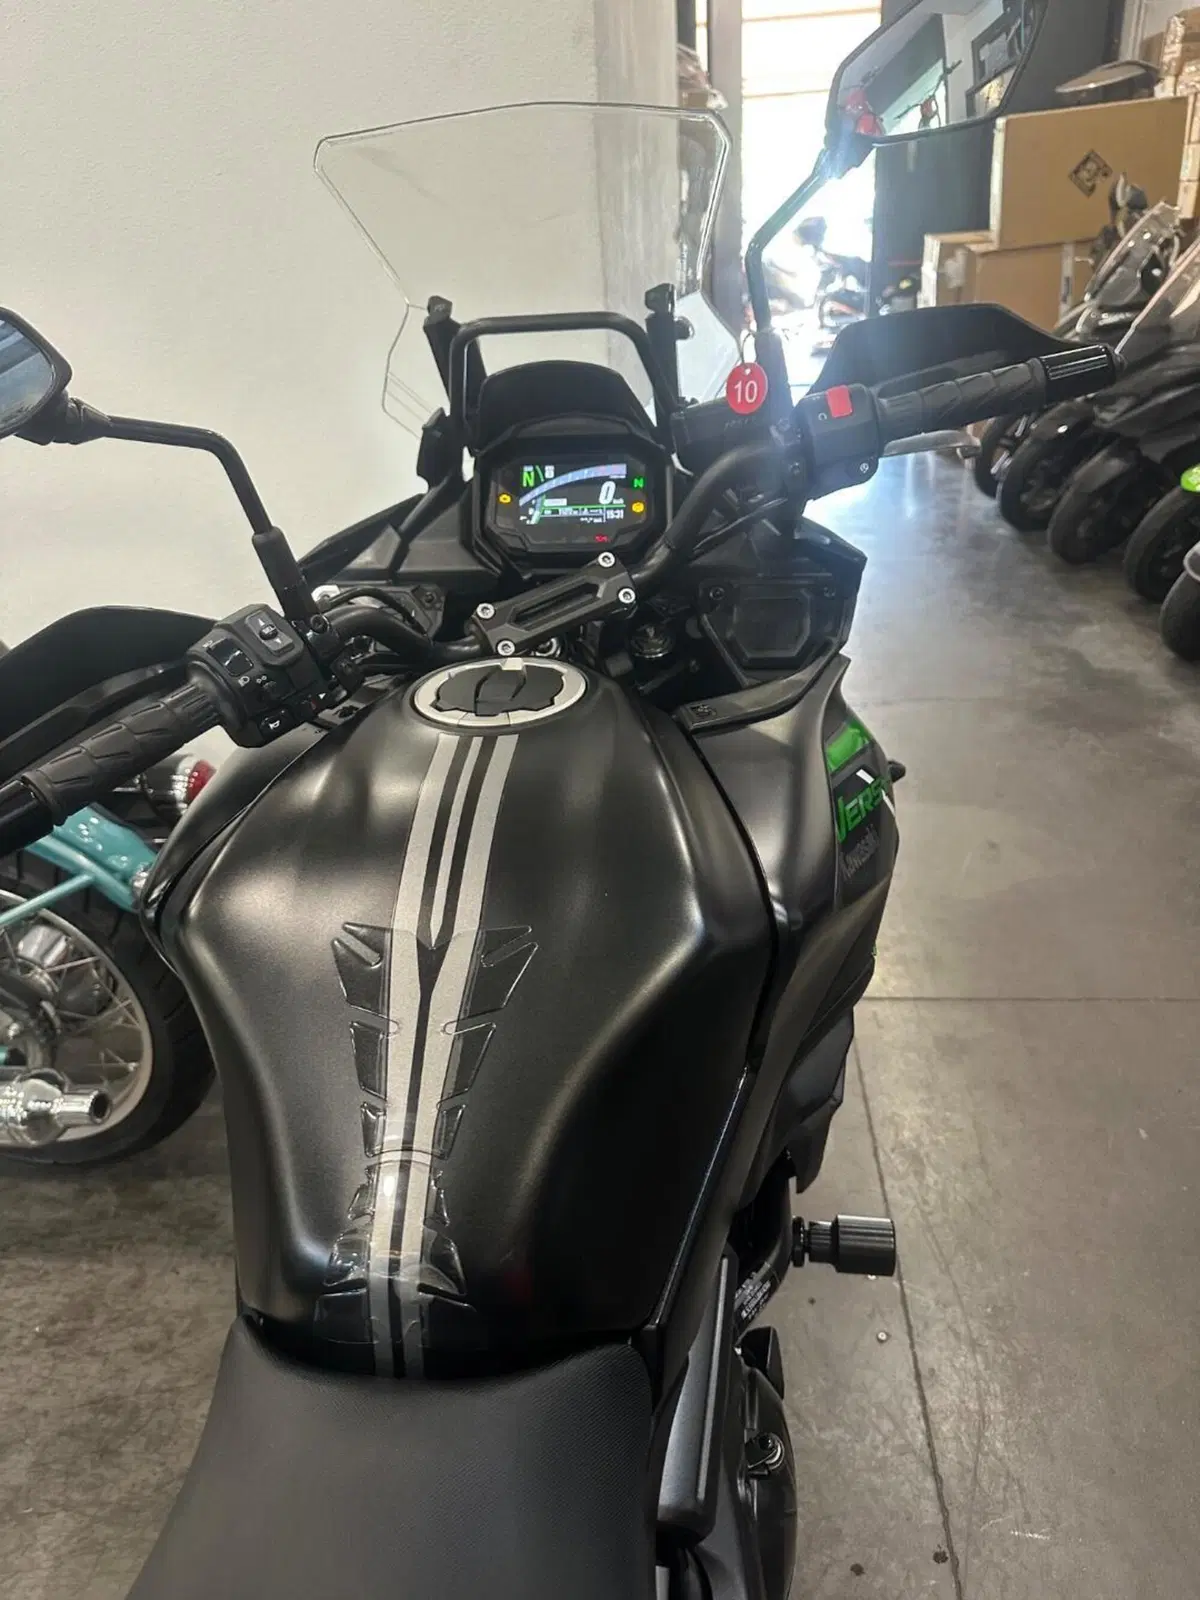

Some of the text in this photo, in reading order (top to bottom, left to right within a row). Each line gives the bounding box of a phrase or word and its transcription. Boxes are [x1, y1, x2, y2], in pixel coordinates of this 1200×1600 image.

[734, 380, 758, 404] 10
[523, 471, 534, 486] N
[634, 478, 643, 488] N
[599, 481, 616, 504] 0
